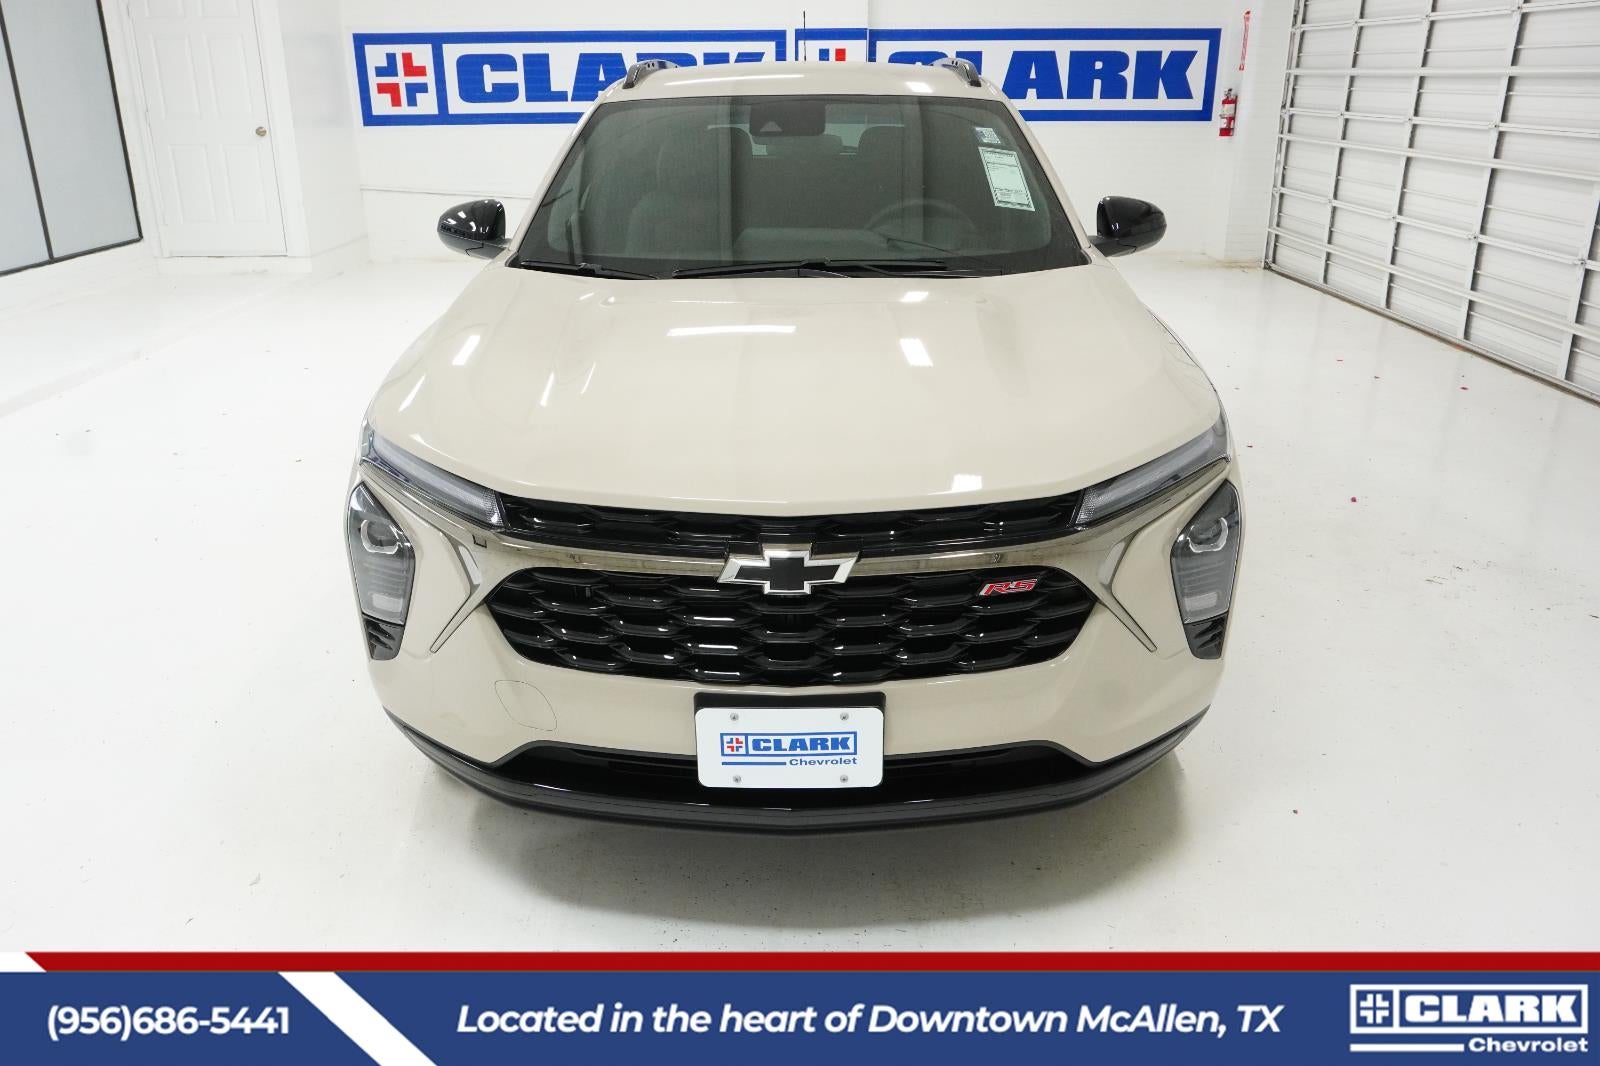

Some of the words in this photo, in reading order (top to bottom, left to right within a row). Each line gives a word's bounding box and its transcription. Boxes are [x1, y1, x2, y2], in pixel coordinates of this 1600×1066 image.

[456, 51, 766, 104] CLA
[888, 50, 1199, 99] ARK
[979, 579, 1038, 596] RS
[752, 737, 850, 751] CLARK
[789, 757, 858, 766] Chevrolet
